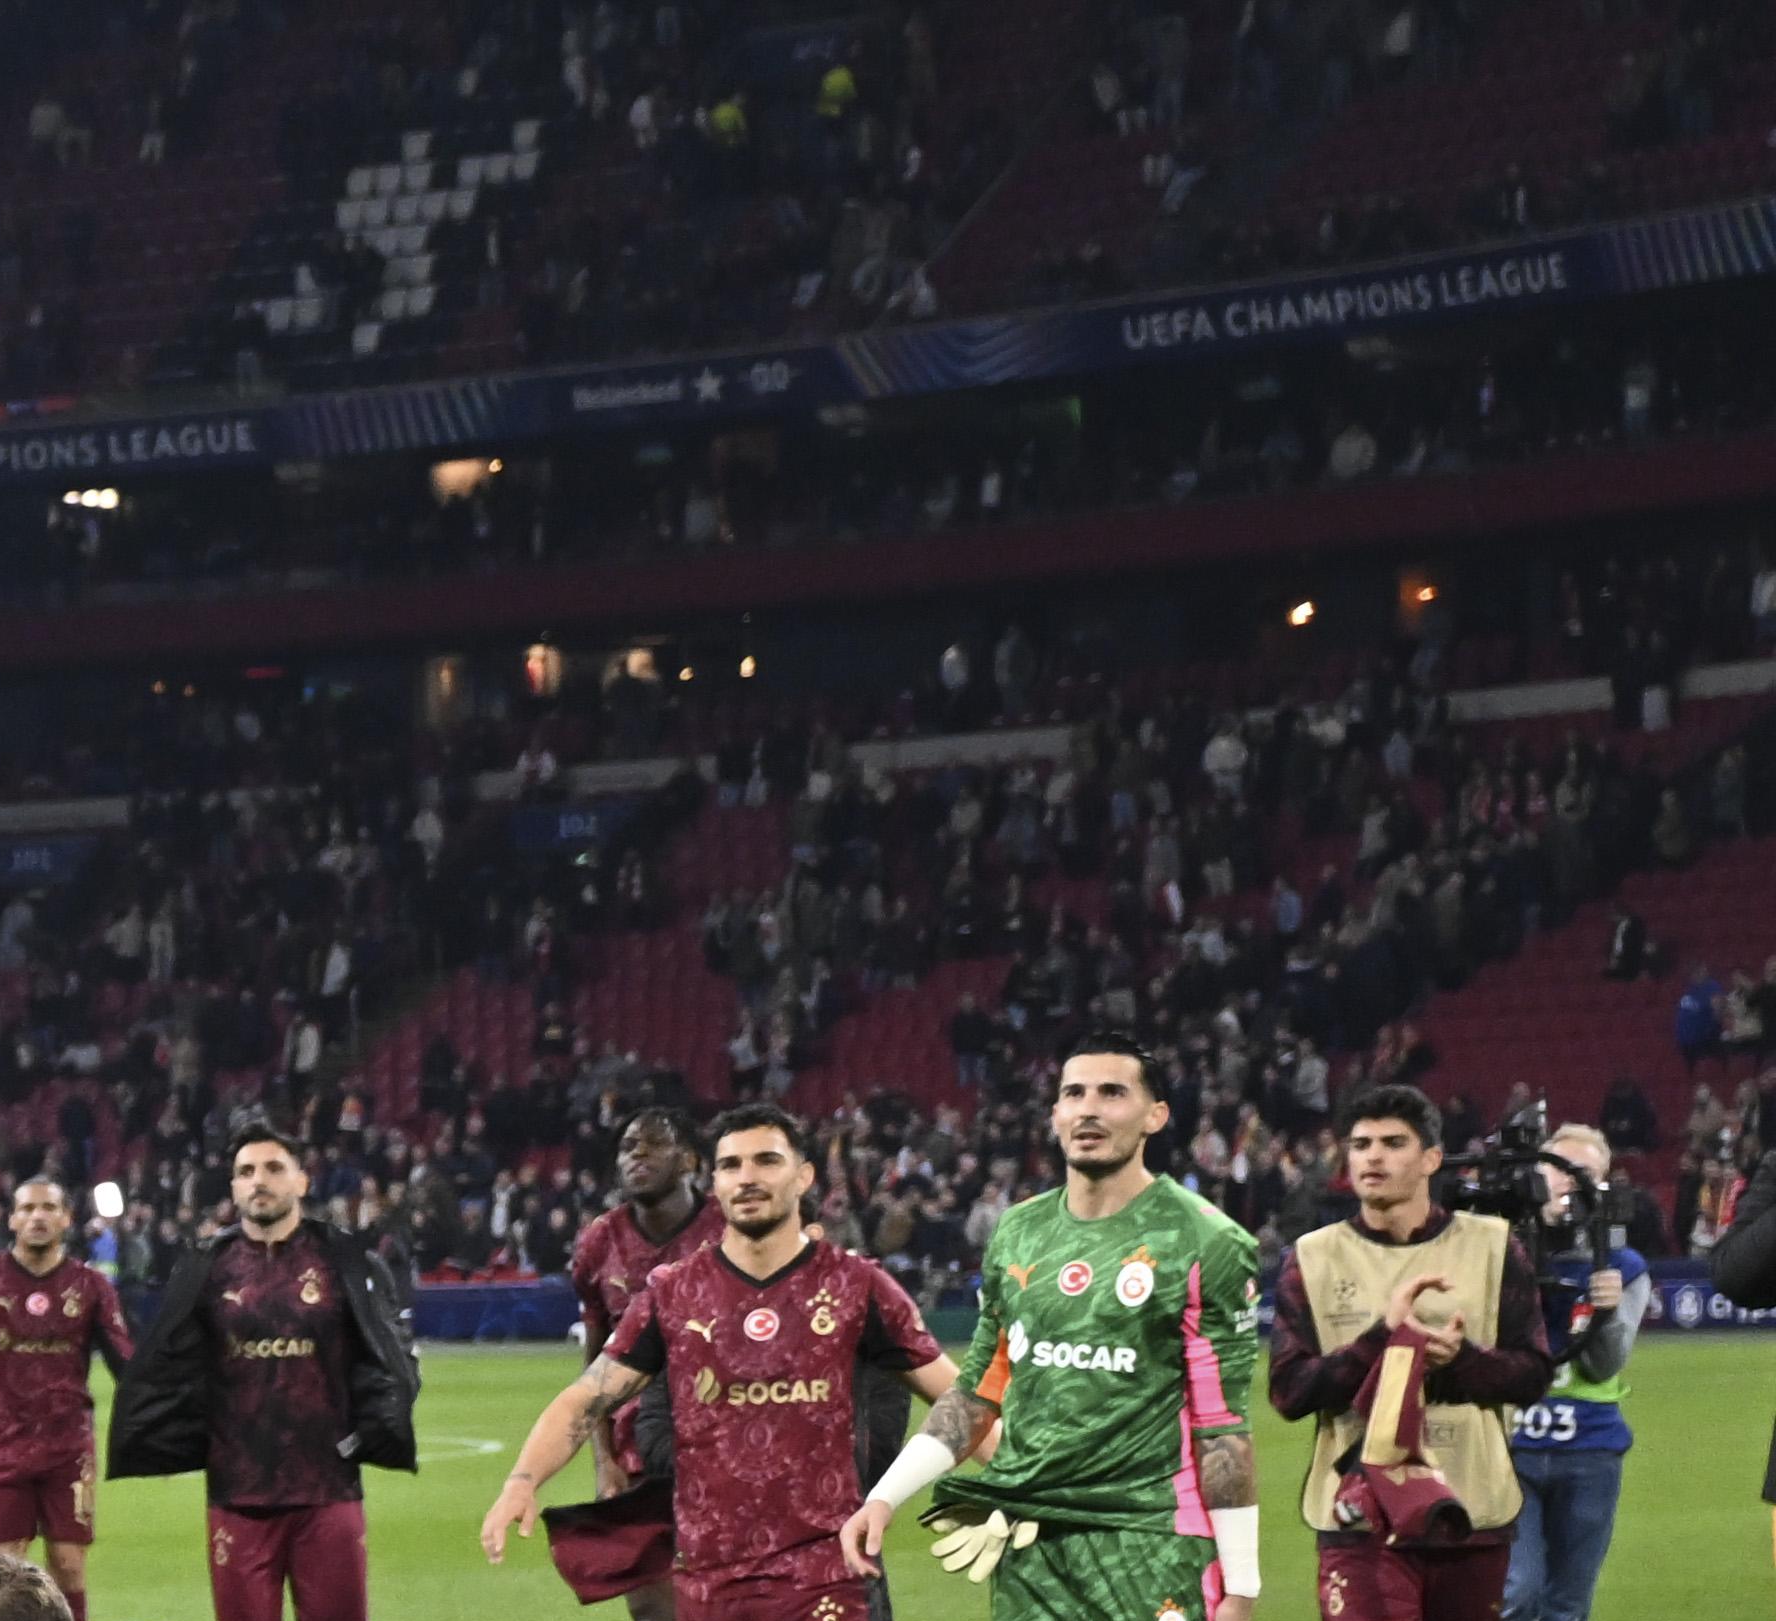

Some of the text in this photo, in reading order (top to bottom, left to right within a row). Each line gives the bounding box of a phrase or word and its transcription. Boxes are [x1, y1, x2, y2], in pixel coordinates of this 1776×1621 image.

[1122, 252, 1567, 351] UEFA CHAMPIONS LEAGUE
[108, 419, 255, 462] LEAGUE
[1032, 1341, 1137, 1373] SOCAR
[727, 1379, 830, 1406] SOCAR
